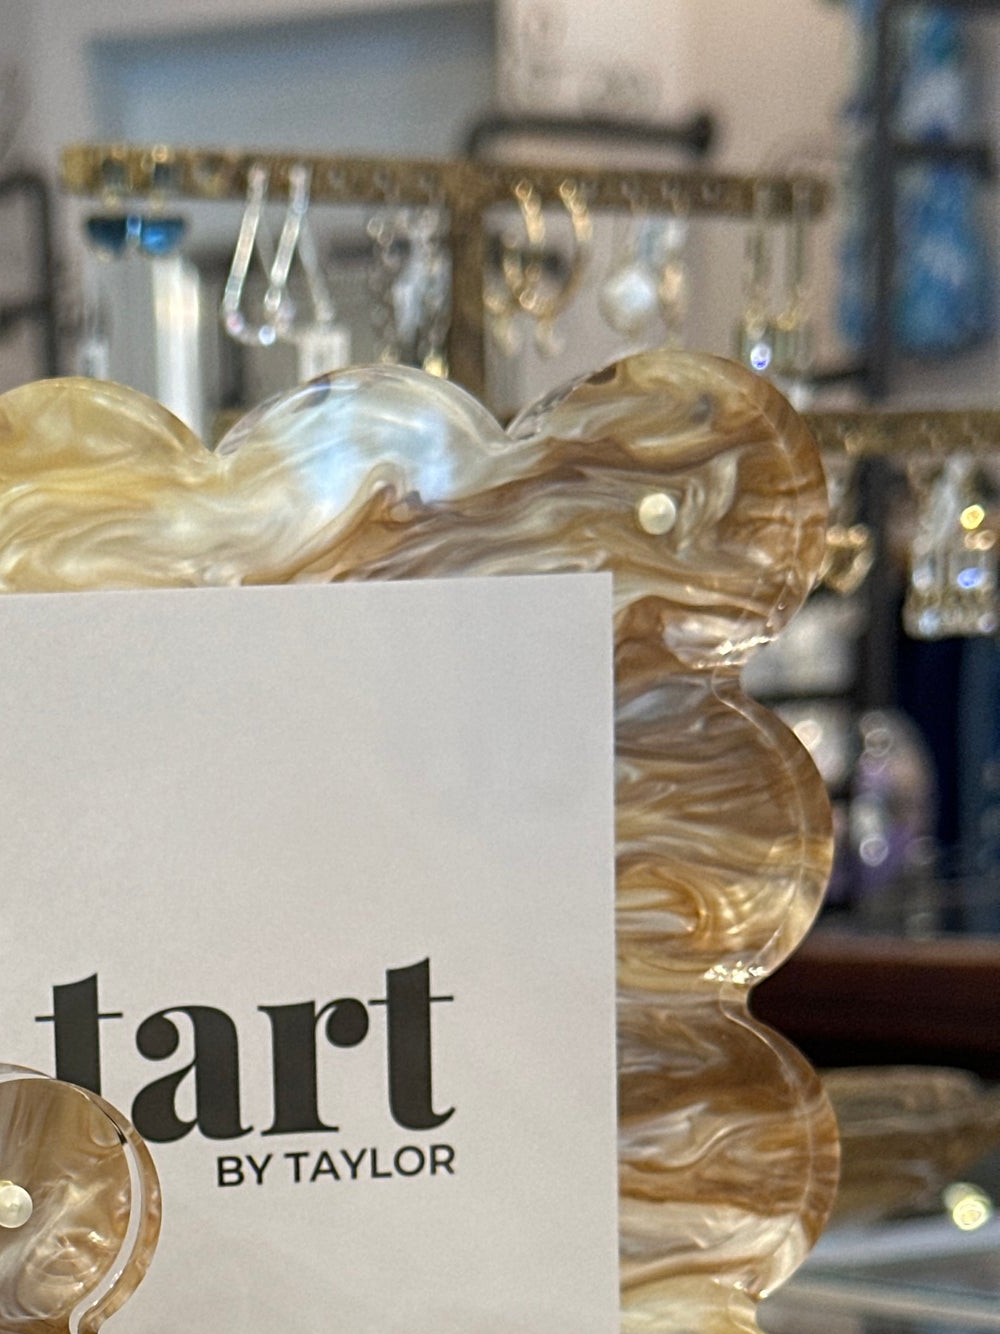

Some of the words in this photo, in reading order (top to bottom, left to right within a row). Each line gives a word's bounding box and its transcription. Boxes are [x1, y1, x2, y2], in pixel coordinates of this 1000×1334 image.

[34, 957, 455, 1144] tart
[217, 1154, 273, 1187] BY
[284, 1145, 455, 1183] TAYLOR
